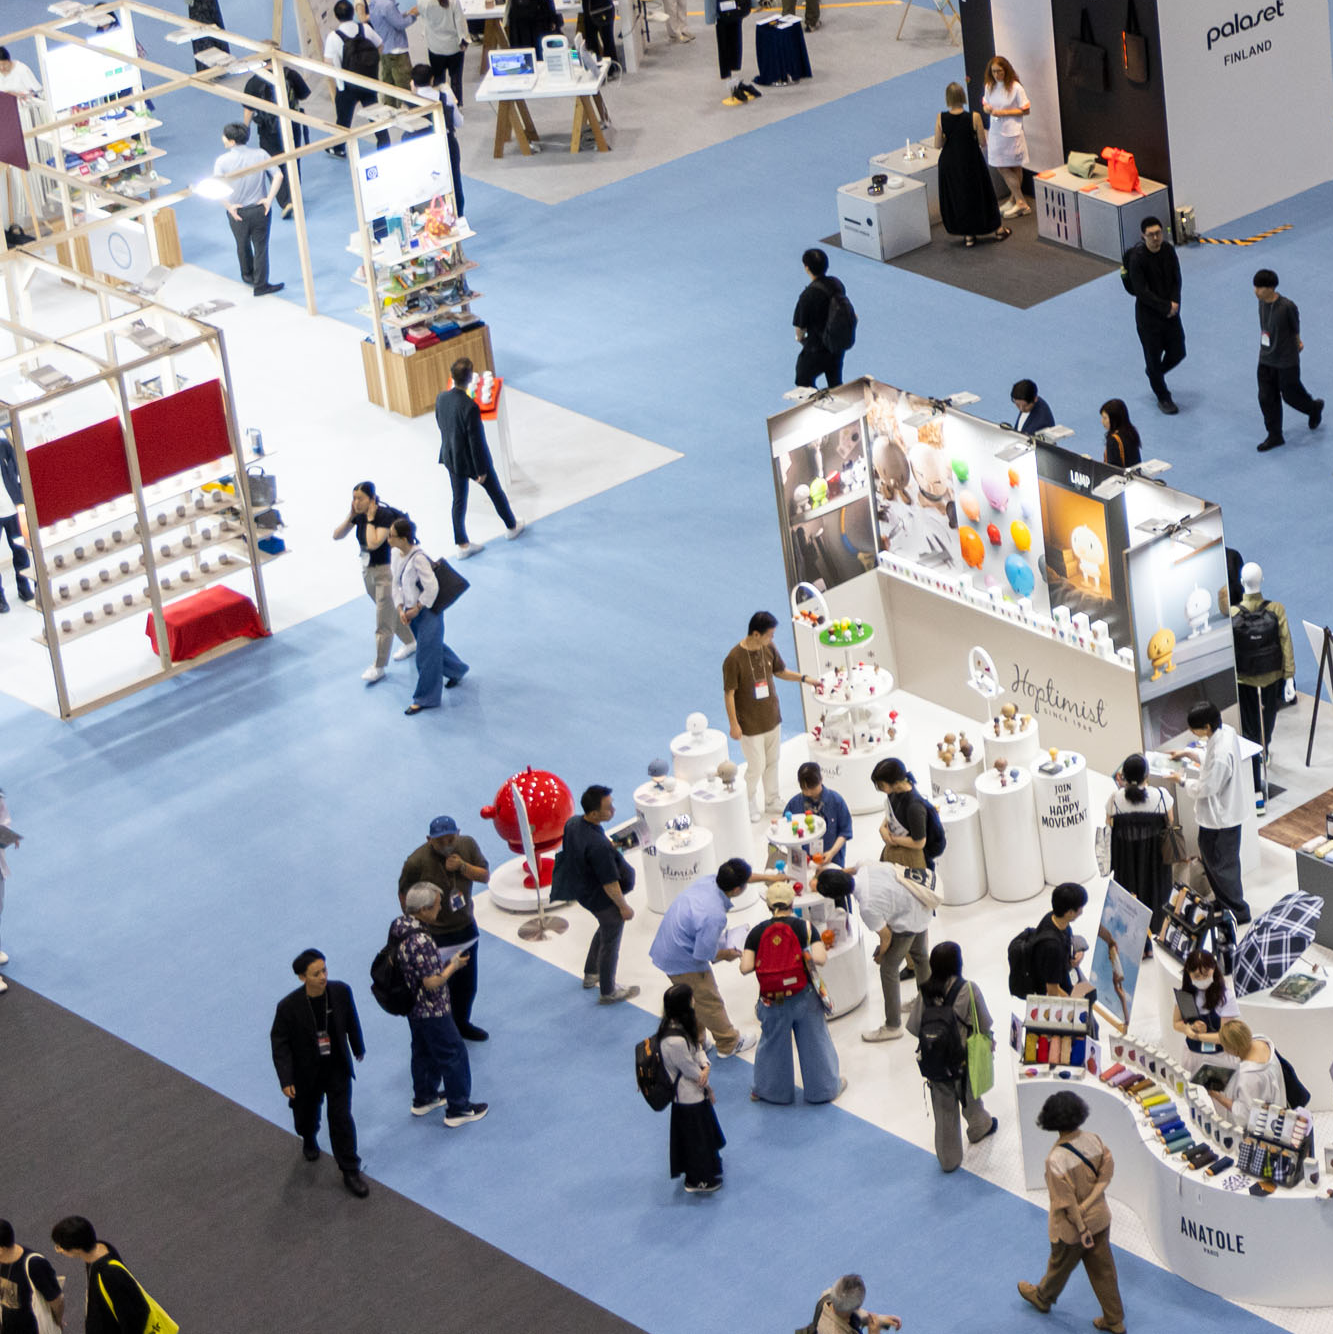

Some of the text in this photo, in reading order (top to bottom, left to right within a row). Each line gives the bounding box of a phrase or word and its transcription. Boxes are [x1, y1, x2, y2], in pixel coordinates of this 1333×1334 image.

[1223, 39, 1272, 67] FINLAND
[1069, 469, 1091, 488] LAMP
[1011, 663, 1108, 729] Hoptimist
[1054, 783, 1072, 794] JOIN
[1049, 800, 1080, 817] HAPPY
[1058, 795, 1070, 804] THE
[1041, 808, 1088, 828] MOVEMENT
[1180, 1216, 1246, 1255] ANATOLE
[1203, 1247, 1219, 1258] PARIS
